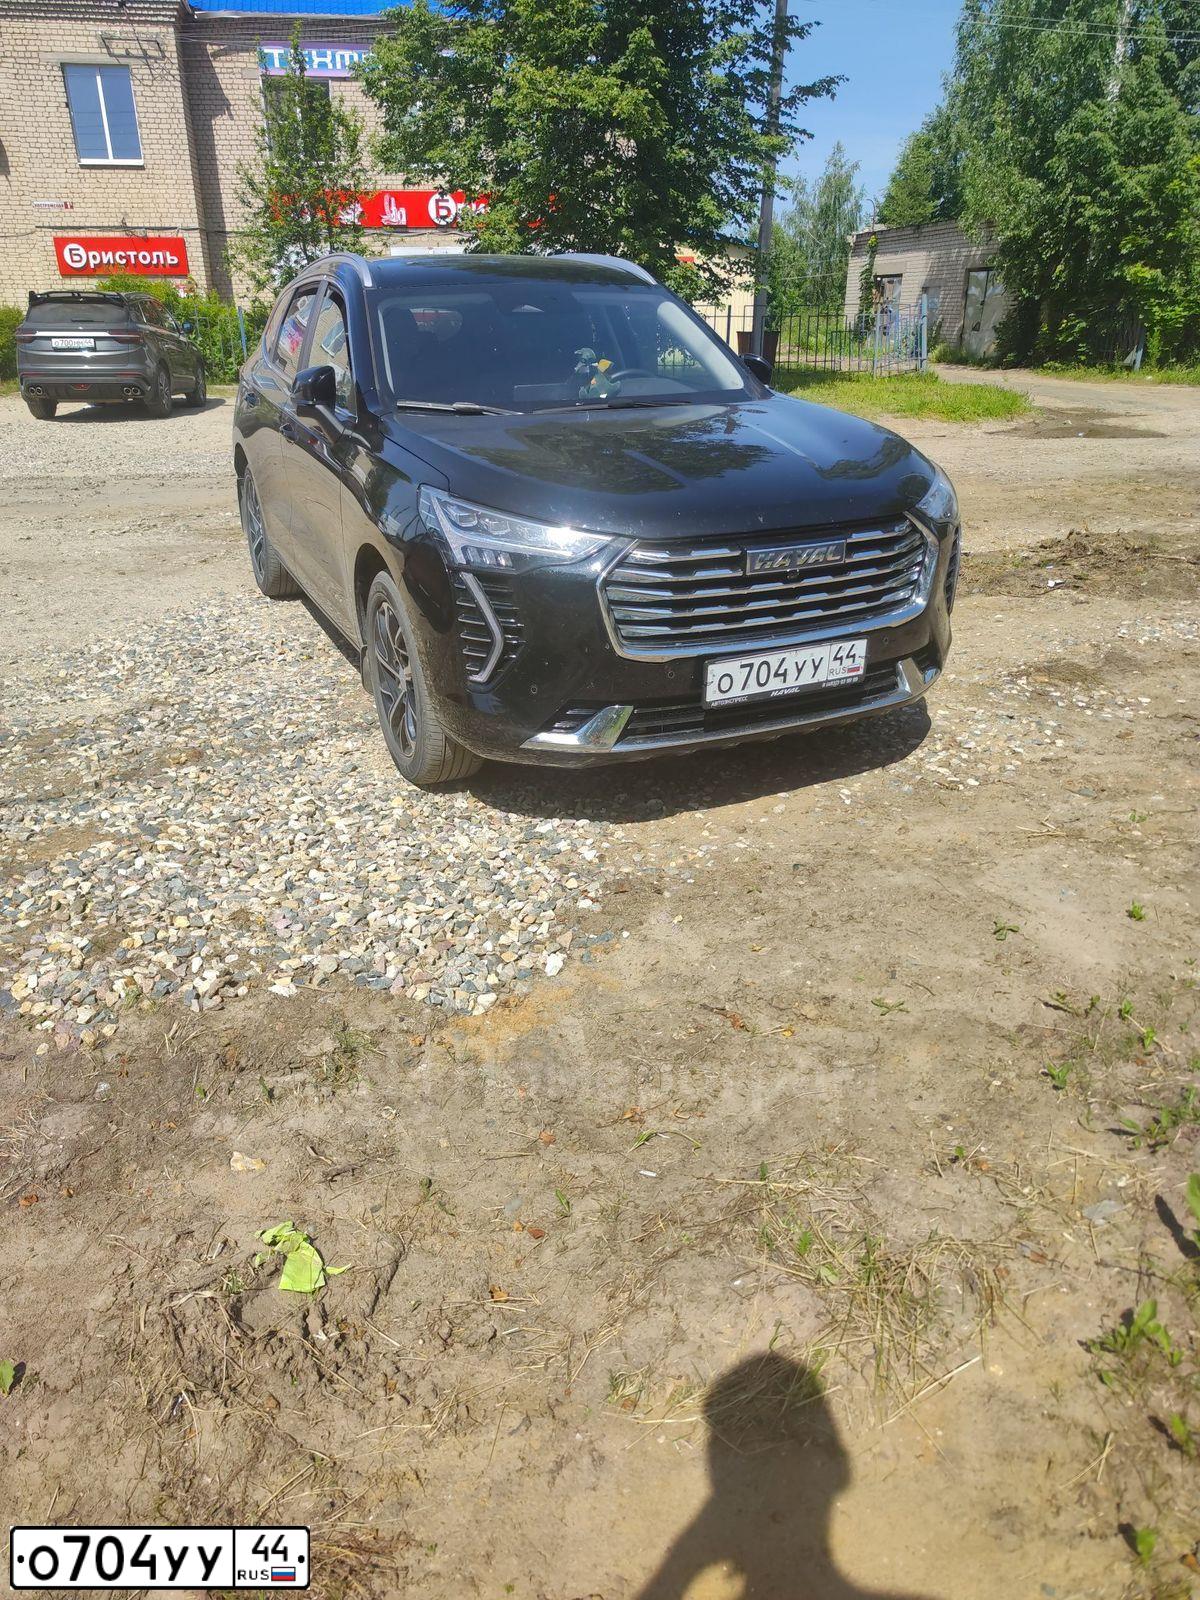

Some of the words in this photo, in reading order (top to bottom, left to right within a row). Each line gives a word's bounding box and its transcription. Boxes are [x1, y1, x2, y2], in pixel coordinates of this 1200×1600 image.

[64, 244, 178, 268] Бристоль
[755, 545, 841, 570] HAVAL
[833, 643, 856, 666] 44
[829, 667, 847, 676] RUS
[770, 687, 800, 697] HAVAL
